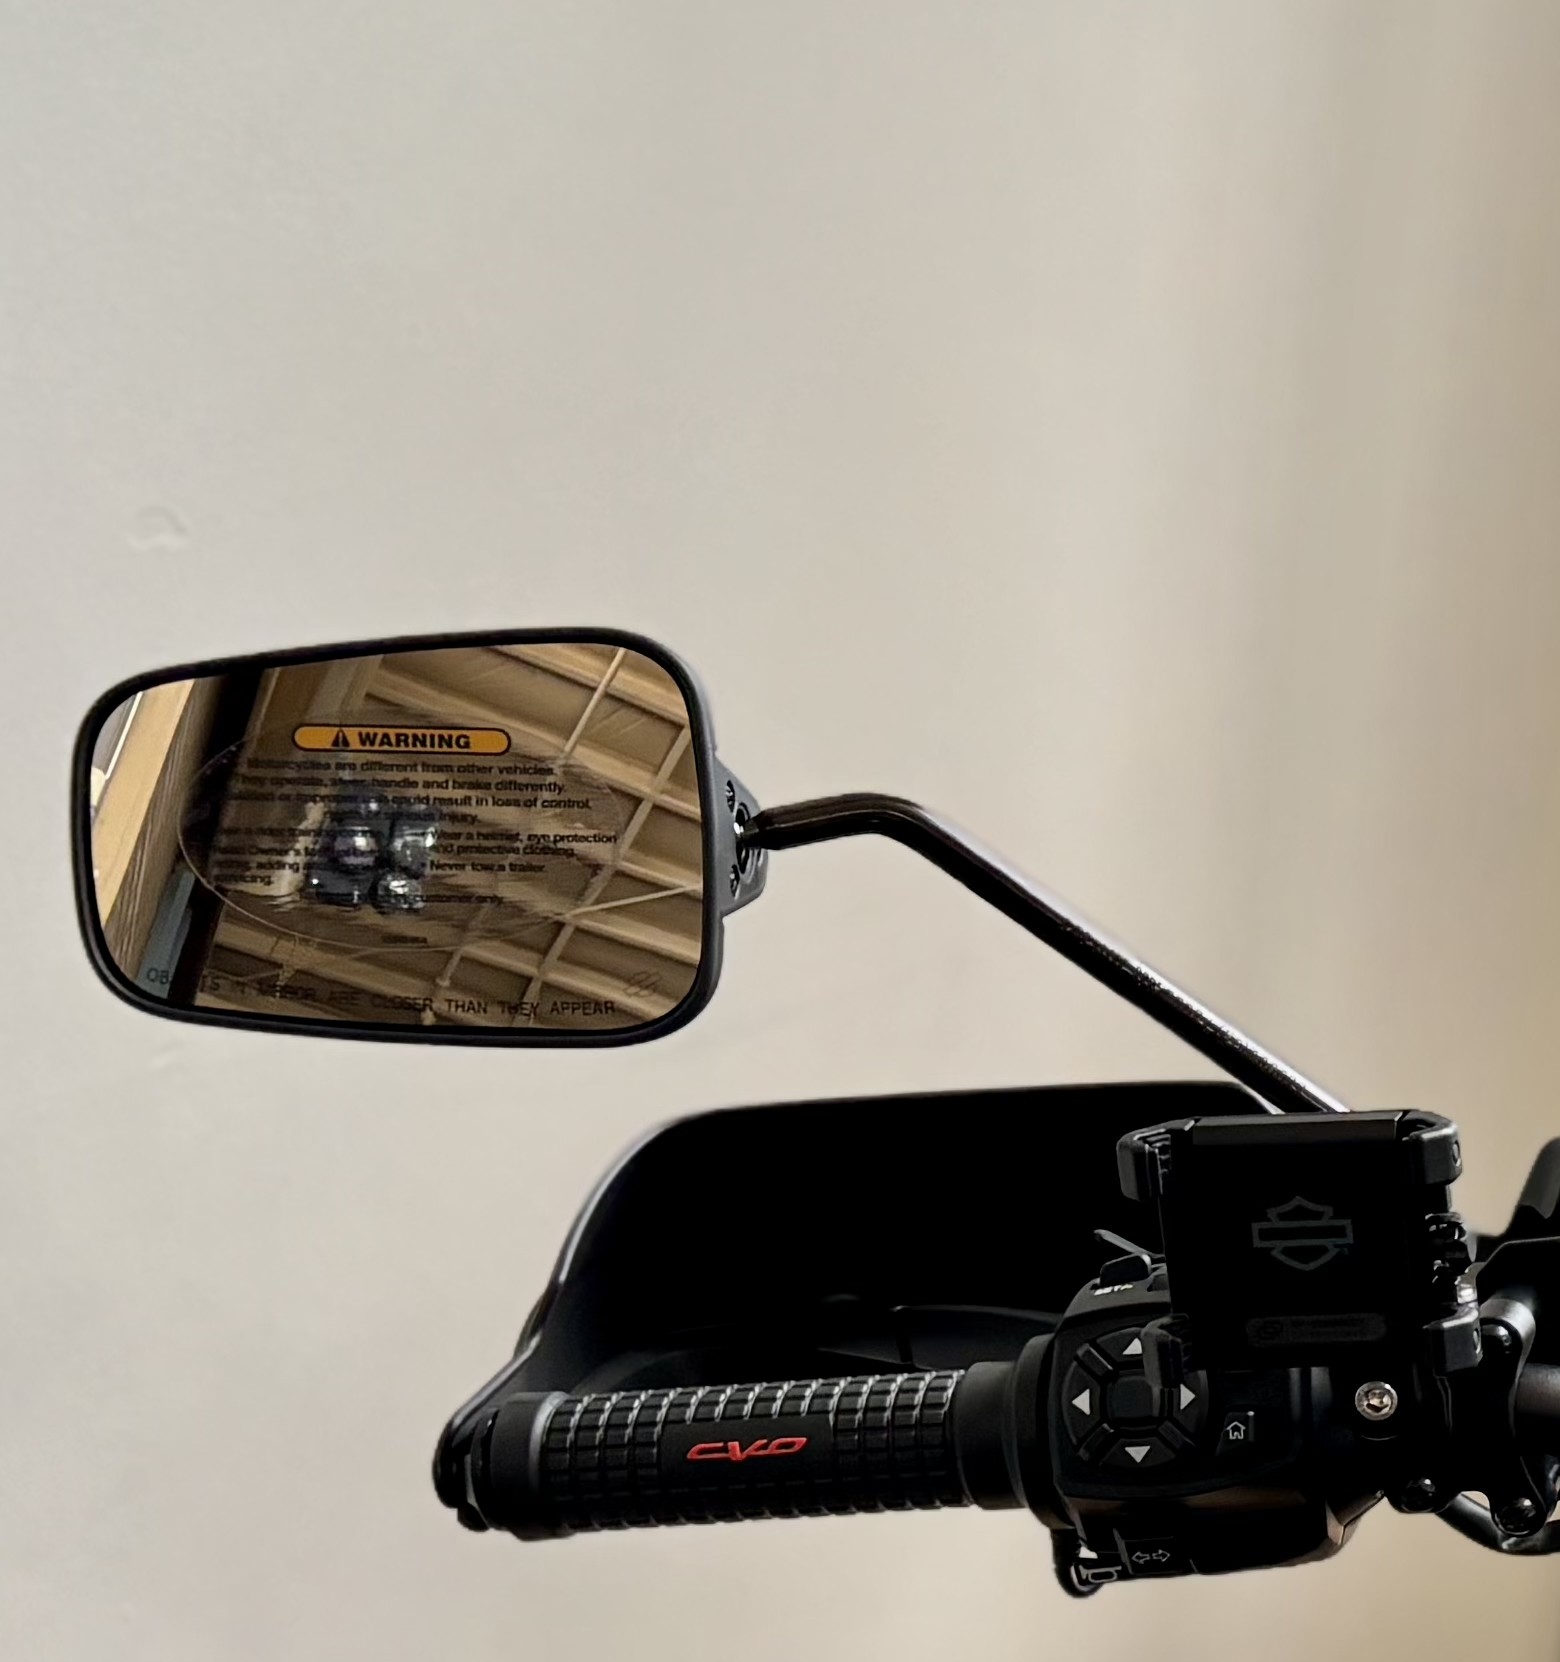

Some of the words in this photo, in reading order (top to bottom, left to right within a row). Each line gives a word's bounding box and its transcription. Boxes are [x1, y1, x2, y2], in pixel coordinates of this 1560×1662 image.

[358, 731, 471, 751] WARNING
[360, 760, 417, 773] different
[421, 762, 454, 774] from
[457, 763, 493, 775] other
[371, 777, 418, 789] handle
[421, 779, 449, 790] and
[452, 779, 491, 791] brake
[494, 780, 566, 796] differently.
[433, 796, 473, 807] result
[475, 796, 488, 807] in
[491, 797, 521, 808] loss
[522, 797, 539, 809] of
[526, 834, 551, 845] eye
[553, 832, 618, 846] protection
[430, 860, 466, 871] Never
[446, 998, 488, 1015] THAN
[501, 1000, 539, 1017] THEY
[550, 1000, 617, 1017] APPEAR
[686, 1437, 808, 1461] CVO
